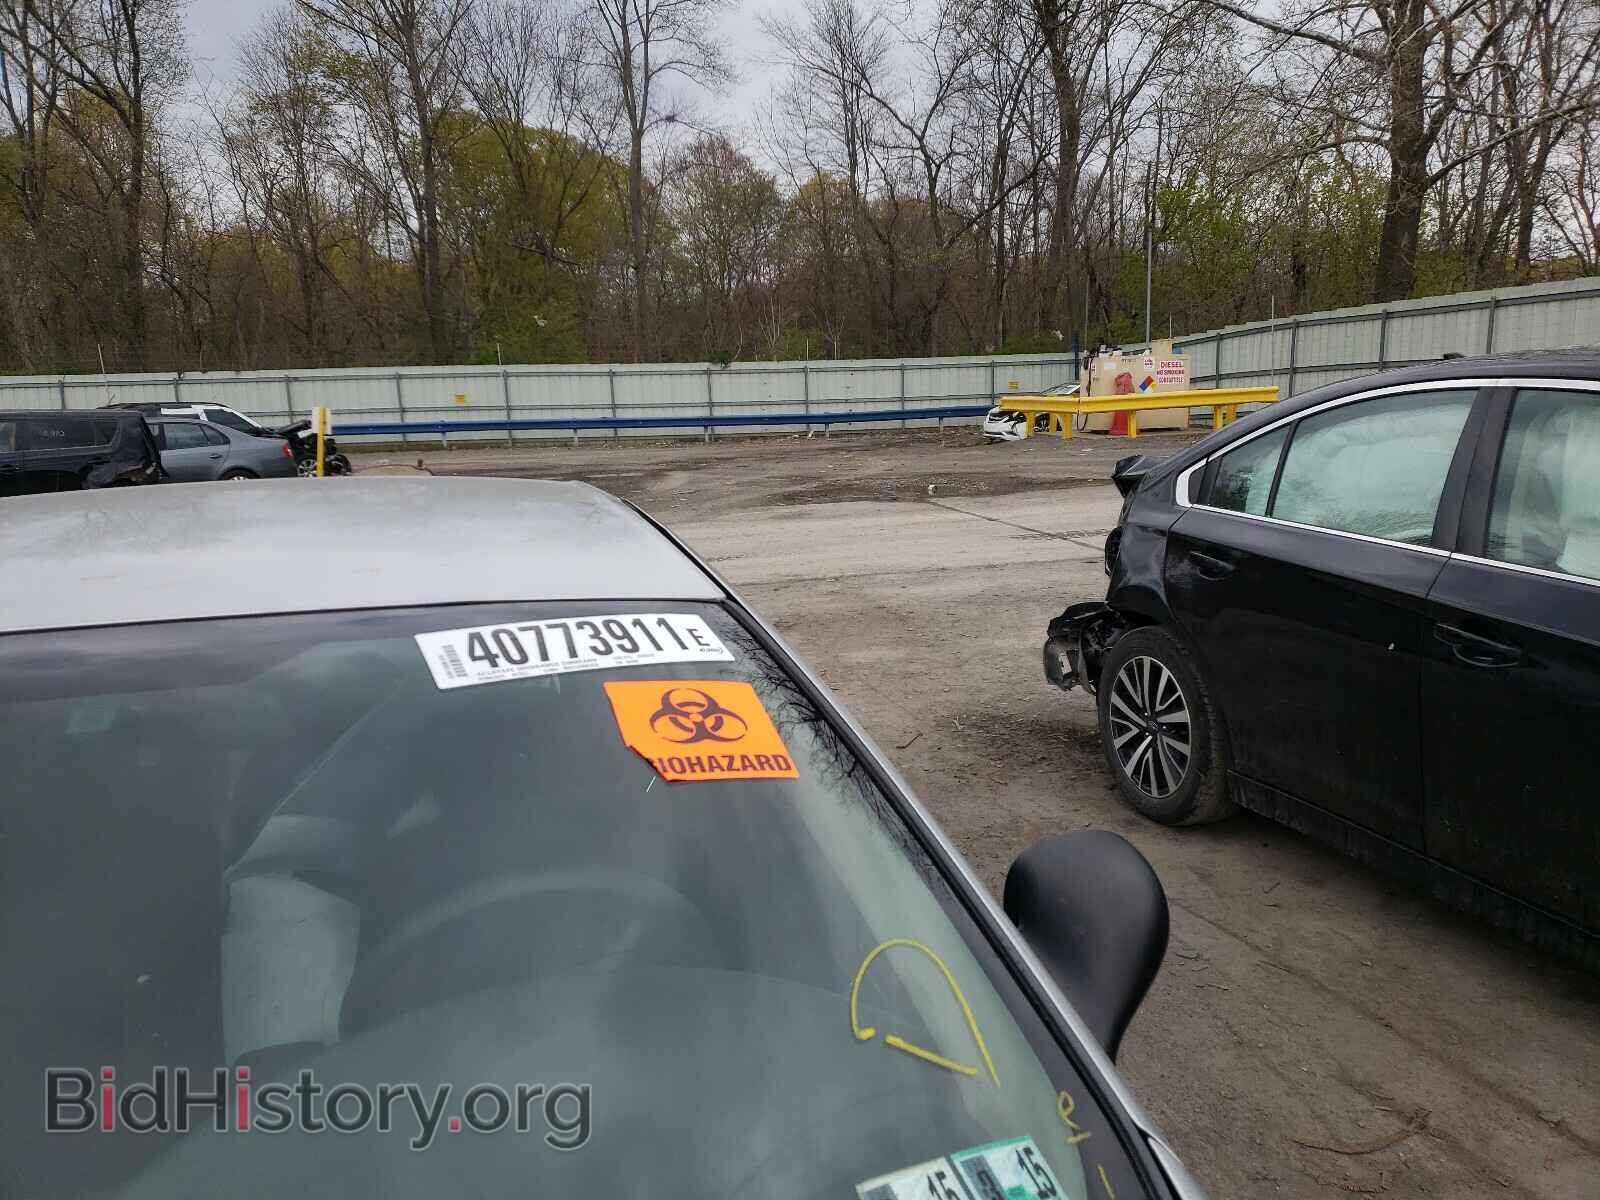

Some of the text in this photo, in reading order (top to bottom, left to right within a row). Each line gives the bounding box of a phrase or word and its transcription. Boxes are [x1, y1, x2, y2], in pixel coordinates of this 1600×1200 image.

[467, 617, 688, 667] 40773911
[687, 628, 709, 647] E
[1014, 1146, 1057, 1199] 15
